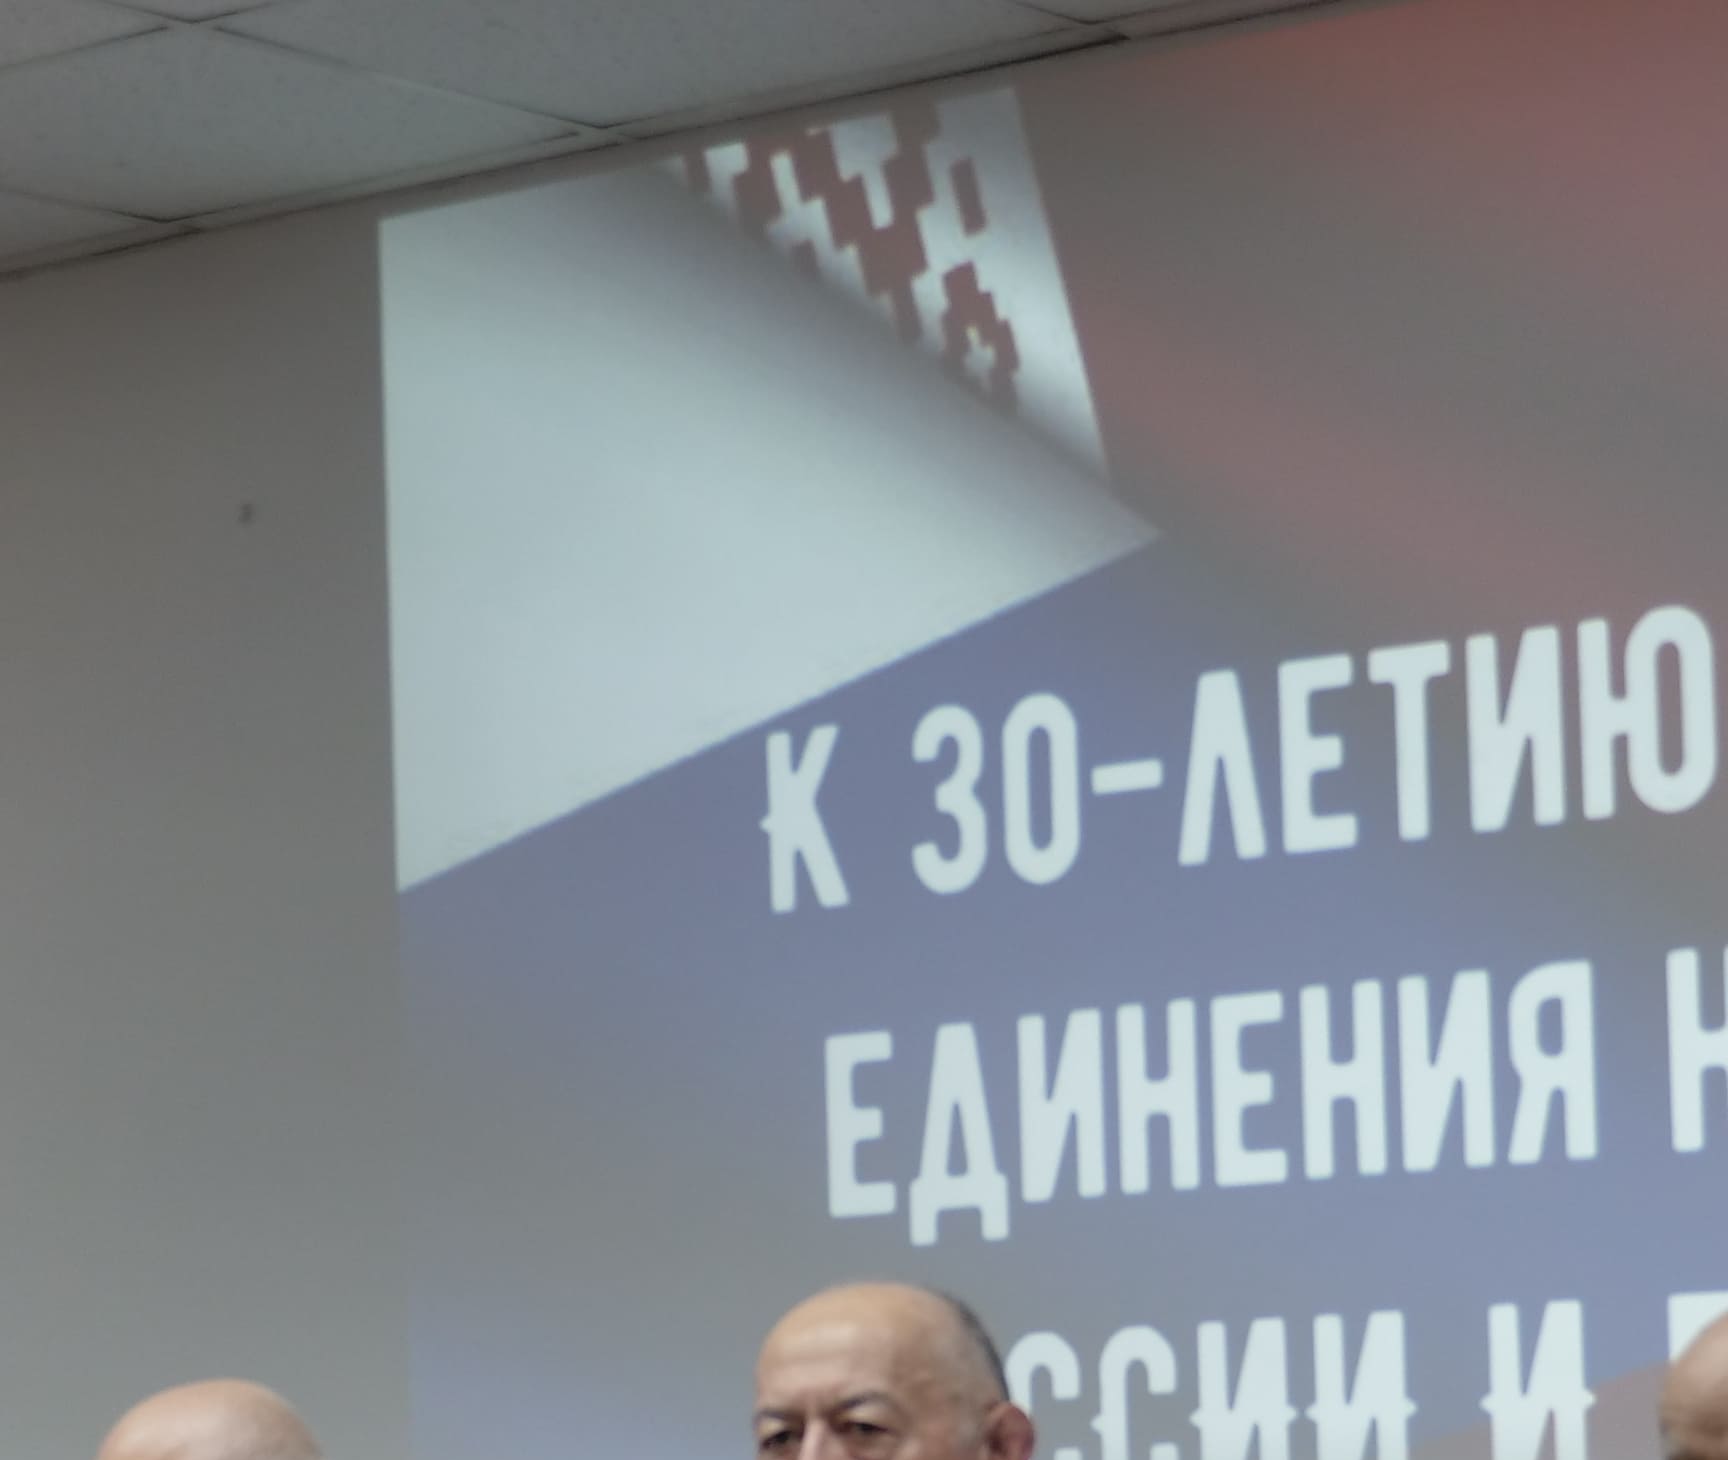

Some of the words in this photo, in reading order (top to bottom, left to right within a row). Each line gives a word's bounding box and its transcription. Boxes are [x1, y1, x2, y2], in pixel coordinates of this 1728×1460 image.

[760, 724, 850, 913] К
[910, 605, 1718, 895] 30-ЛЕТИЮ
[824, 959, 1598, 1247] ЕДИНЕНИЯ
